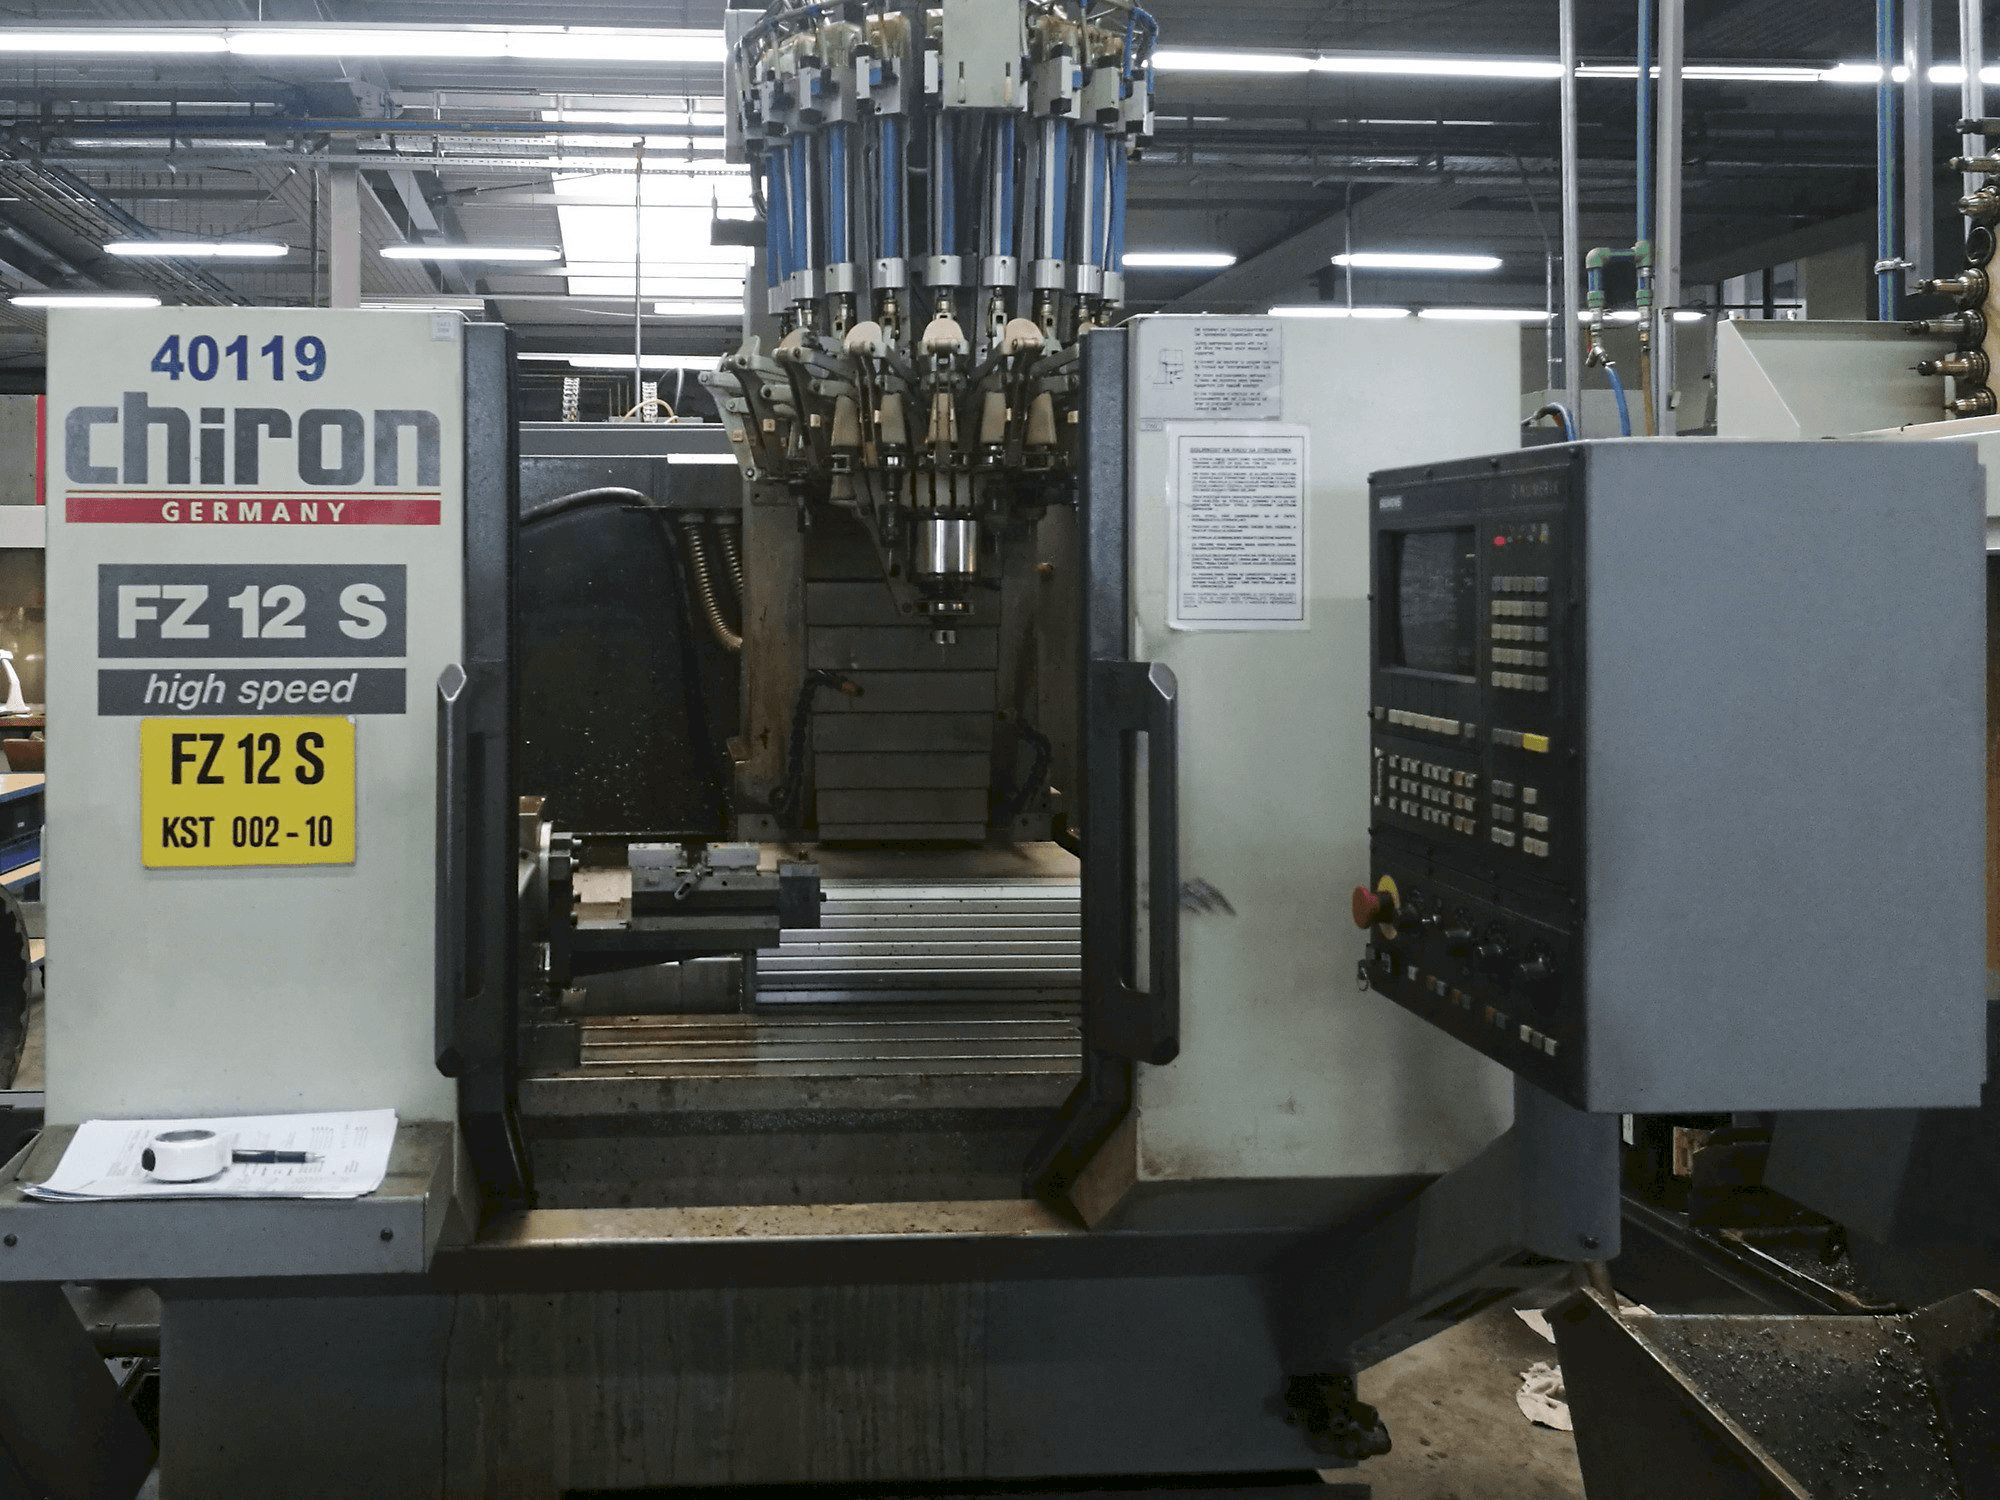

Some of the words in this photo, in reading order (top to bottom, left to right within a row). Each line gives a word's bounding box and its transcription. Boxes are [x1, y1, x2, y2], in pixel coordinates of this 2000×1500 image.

[151, 335, 326, 381] 40119
[65, 392, 440, 486] chiron
[162, 502, 345, 522] GERMANY
[118, 585, 209, 638] FZ
[229, 585, 306, 638] 12
[339, 583, 387, 639] S
[145, 674, 225, 711] high
[238, 673, 357, 711] speed
[171, 733, 224, 784] FZ
[238, 733, 281, 784] 12
[296, 732, 324, 785] S
[162, 816, 214, 848] KST
